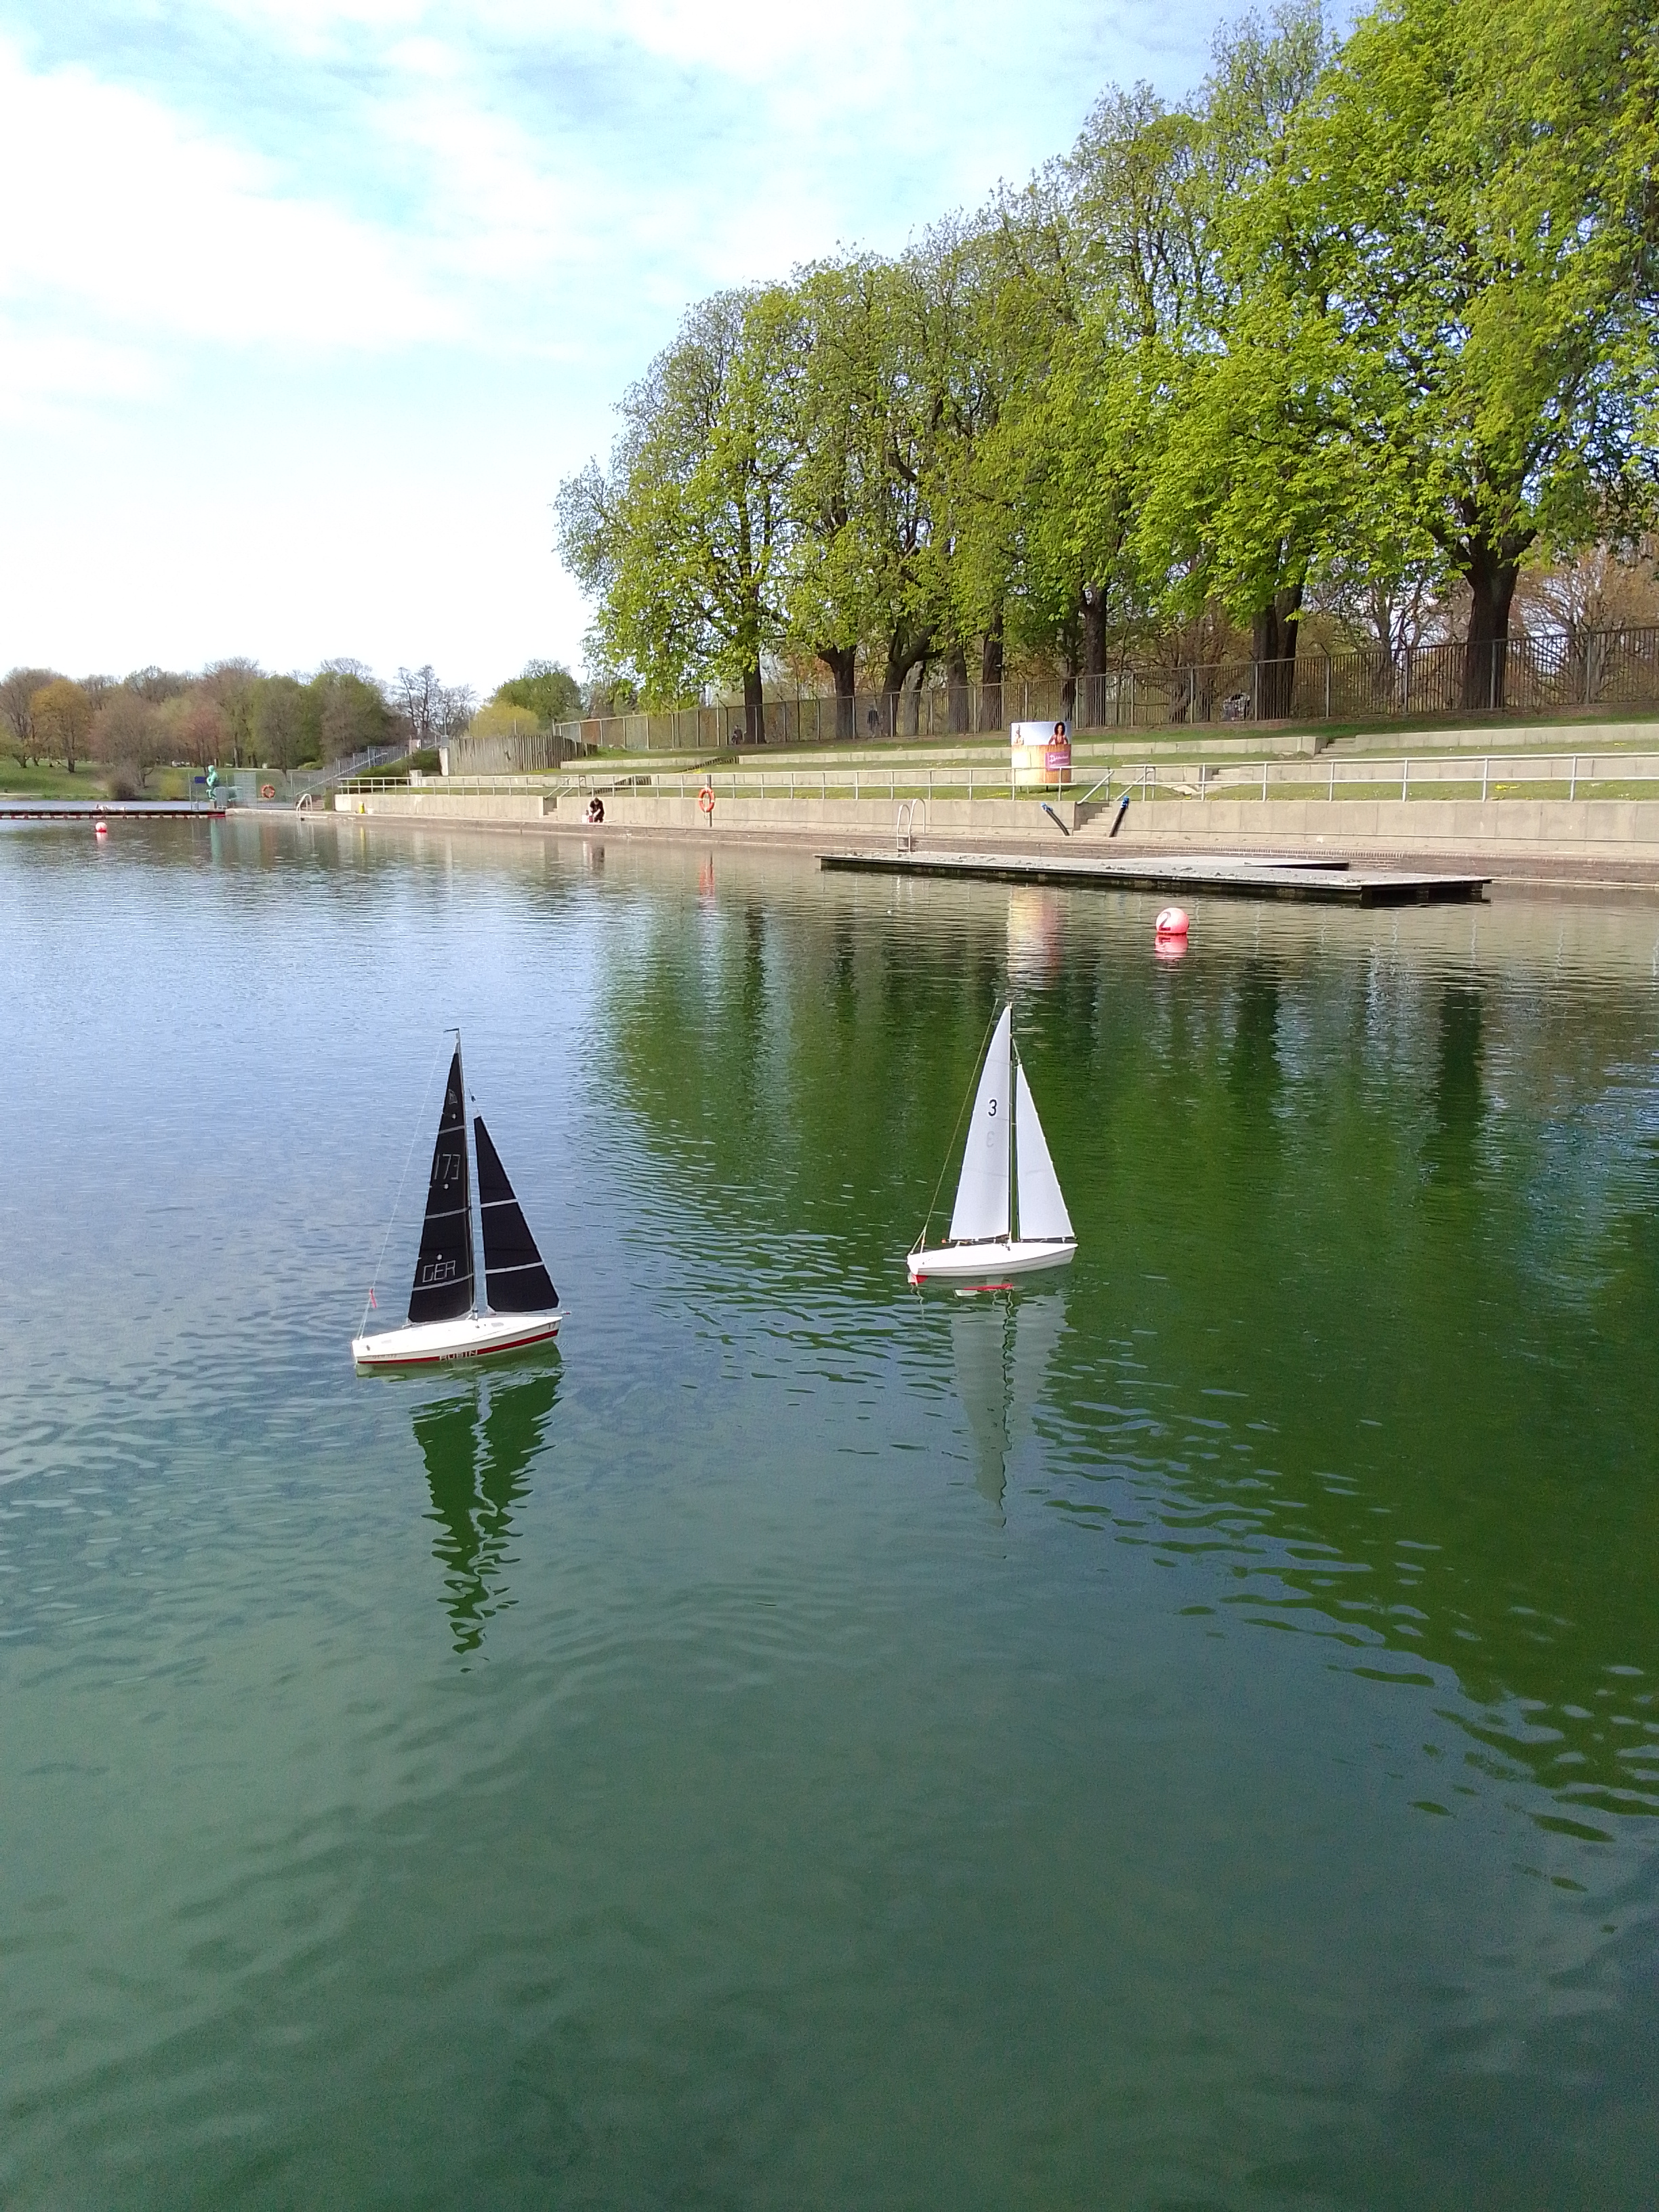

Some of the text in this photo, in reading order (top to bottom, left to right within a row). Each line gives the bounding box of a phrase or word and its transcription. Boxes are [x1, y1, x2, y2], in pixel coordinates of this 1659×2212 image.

[1159, 911, 1171, 931] 2
[988, 1099, 997, 1117] 3
[434, 1154, 461, 1179] 173
[422, 1260, 455, 1283] GER
